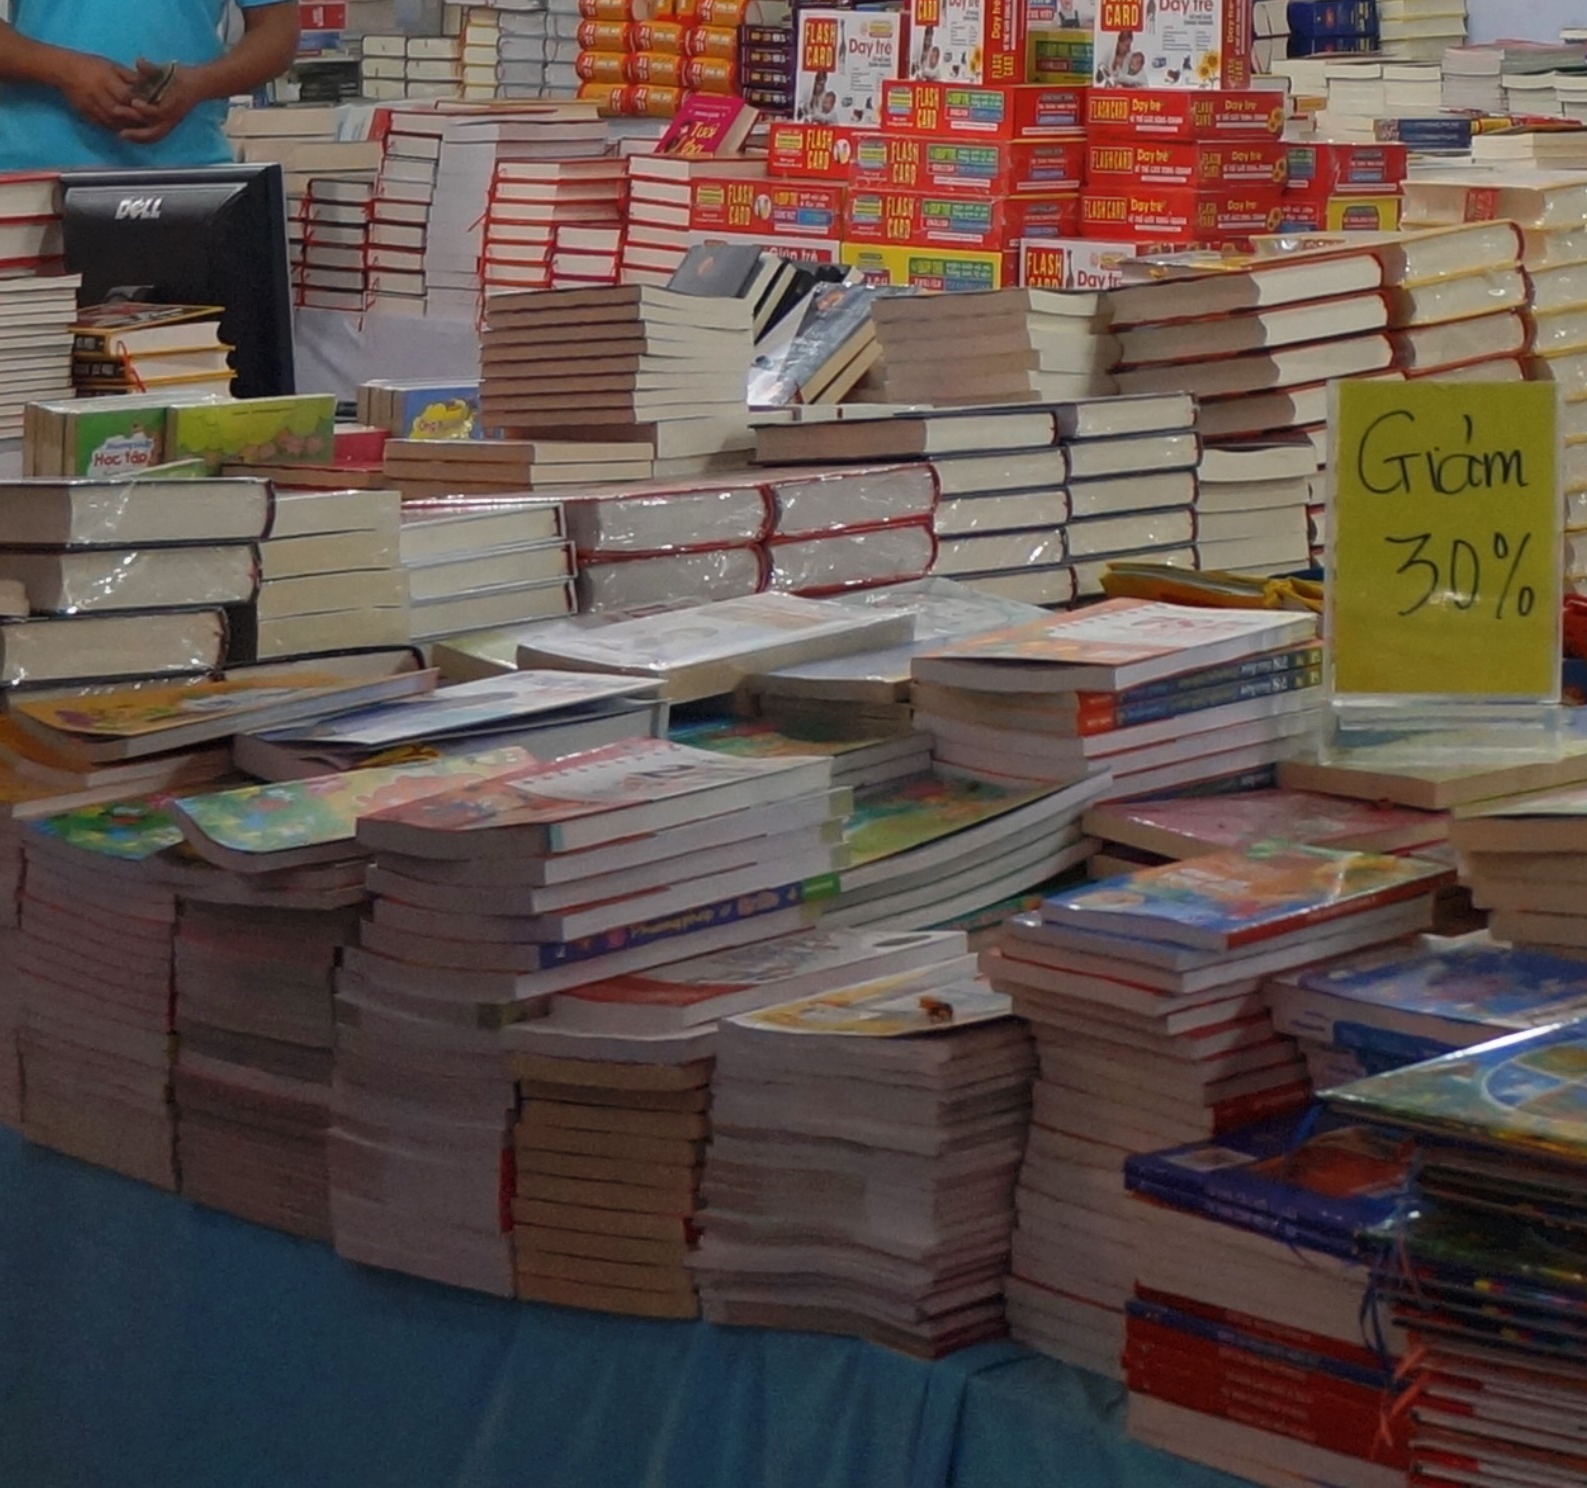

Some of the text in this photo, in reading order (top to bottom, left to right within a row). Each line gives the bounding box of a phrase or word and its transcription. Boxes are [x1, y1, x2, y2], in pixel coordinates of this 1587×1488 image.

[1104, 4, 1140, 28] CARD
[804, 20, 836, 45] FLASH
[805, 45, 834, 69] CARD
[806, 128, 834, 152] FLASH
[807, 150, 830, 171] CARD
[115, 197, 163, 220] DELL
[1026, 251, 1062, 277] FLASH
[1385, 532, 1535, 620] 30%
